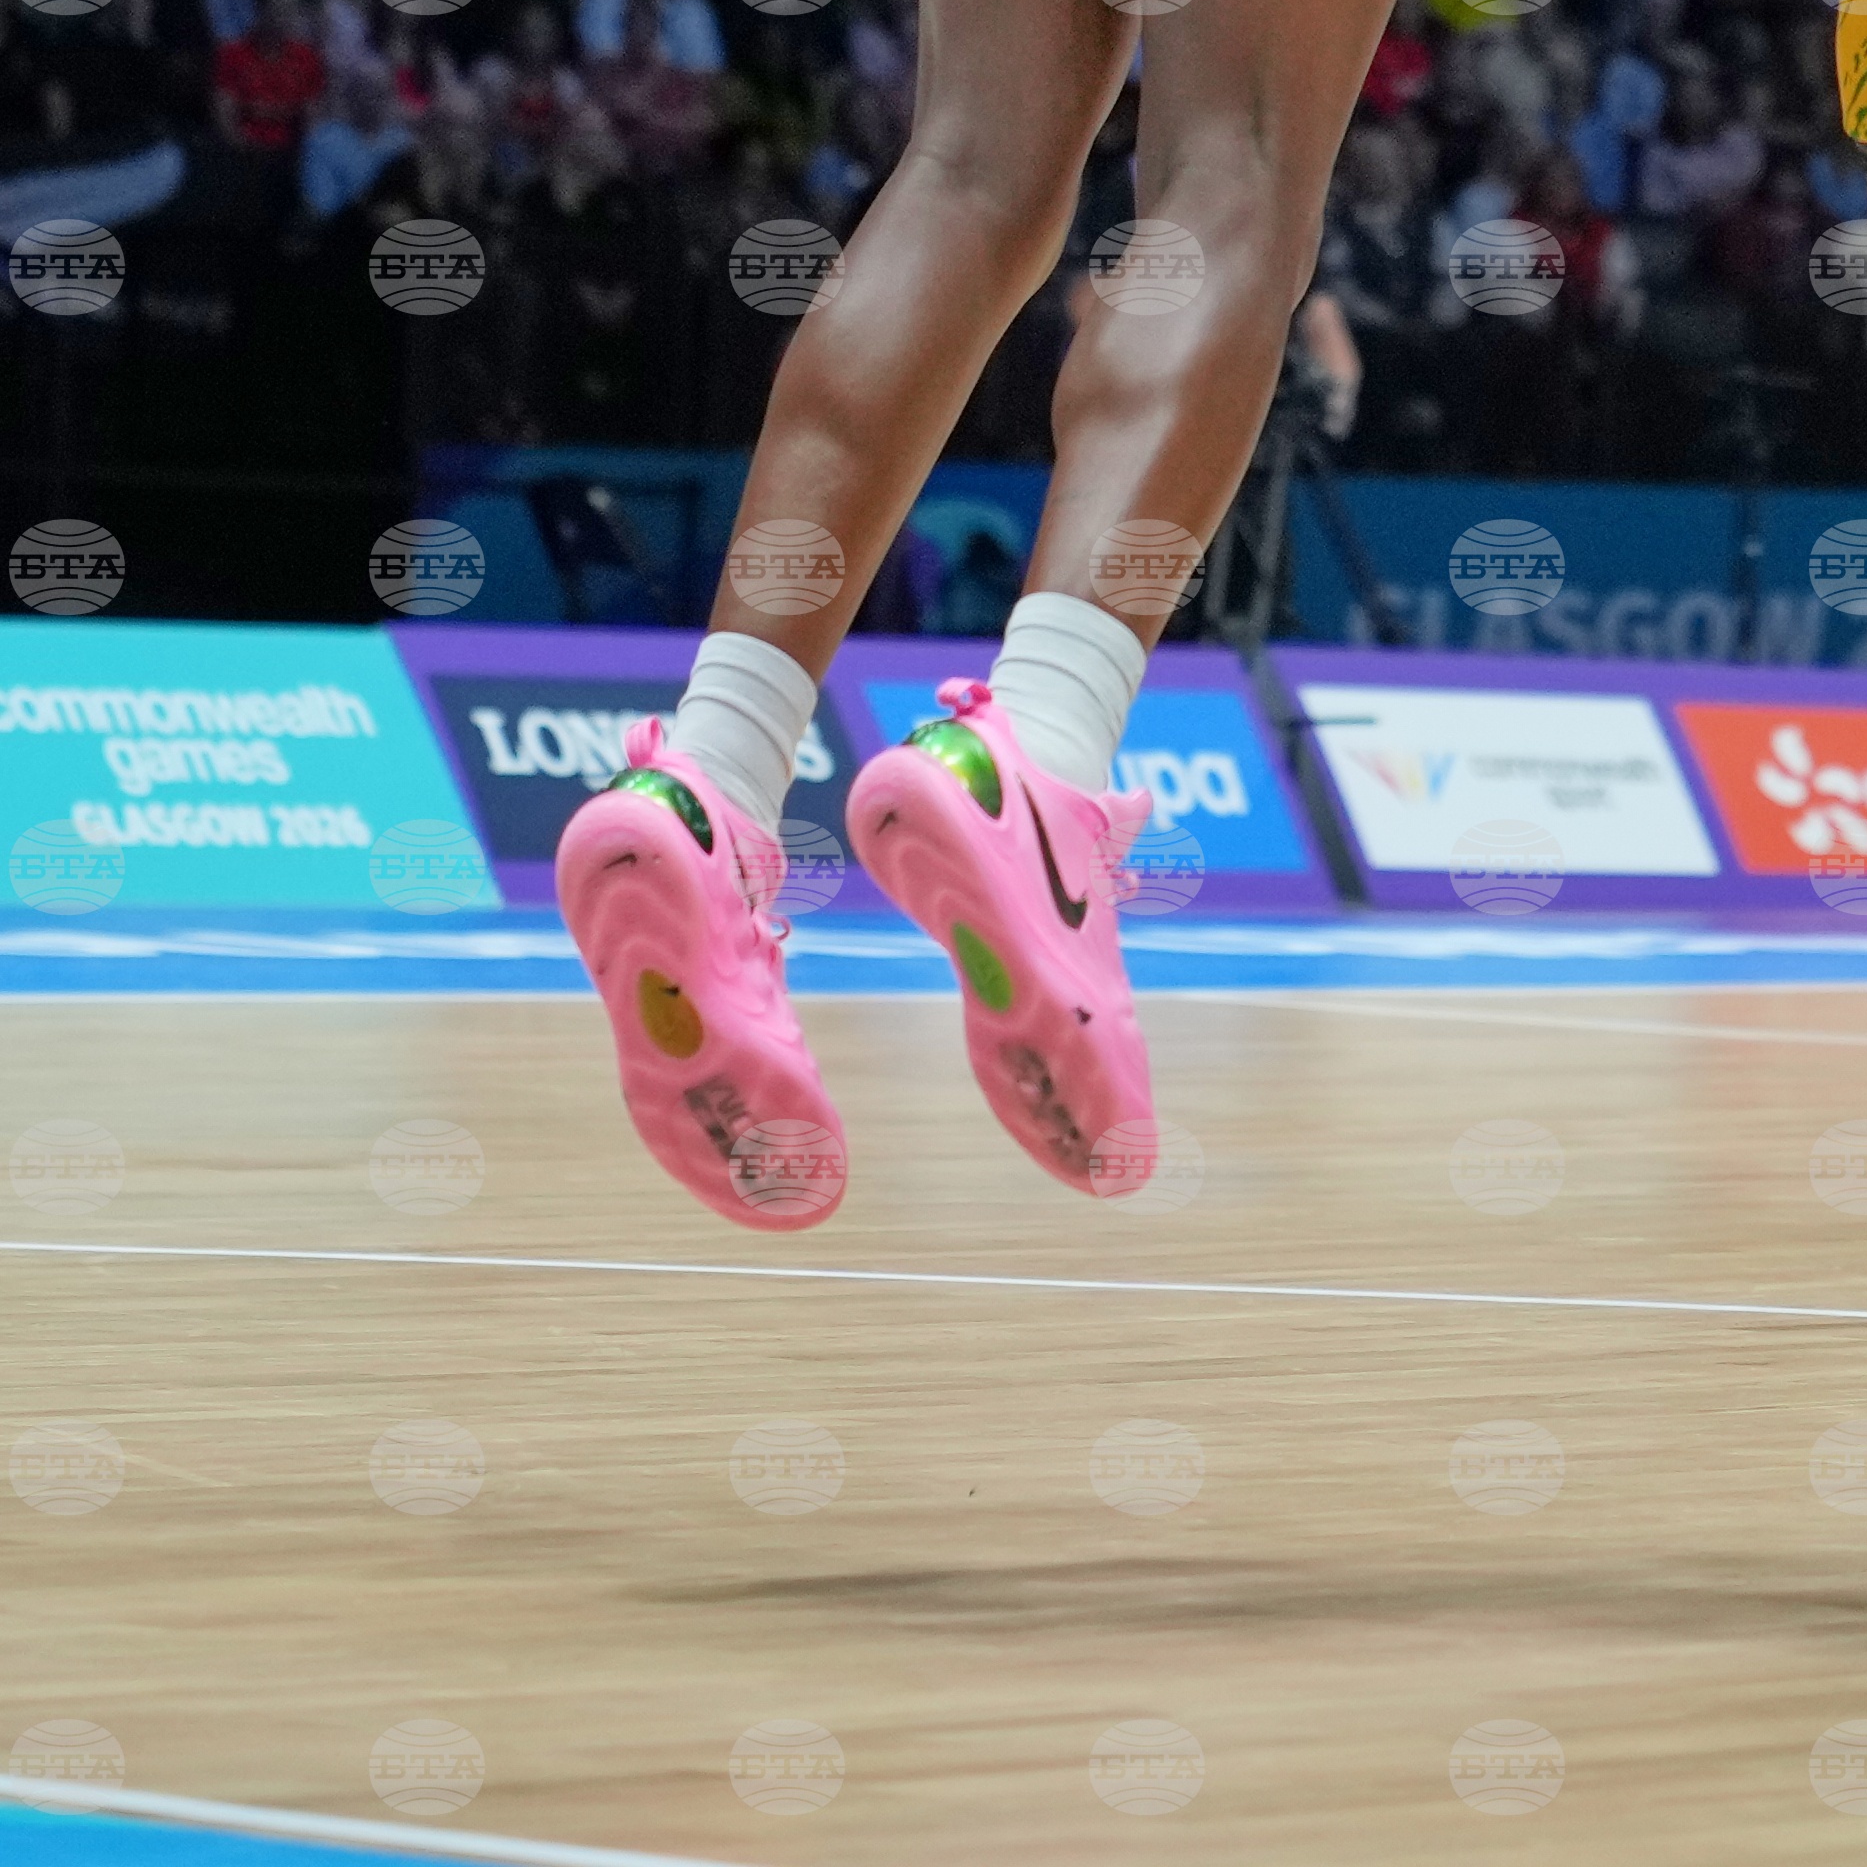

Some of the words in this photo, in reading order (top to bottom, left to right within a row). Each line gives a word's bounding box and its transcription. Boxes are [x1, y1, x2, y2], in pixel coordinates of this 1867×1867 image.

[0, 684, 378, 738] commonwealth
[102, 736, 291, 797] games
[70, 801, 271, 847] GLASGOW
[270, 804, 374, 849] 2026
